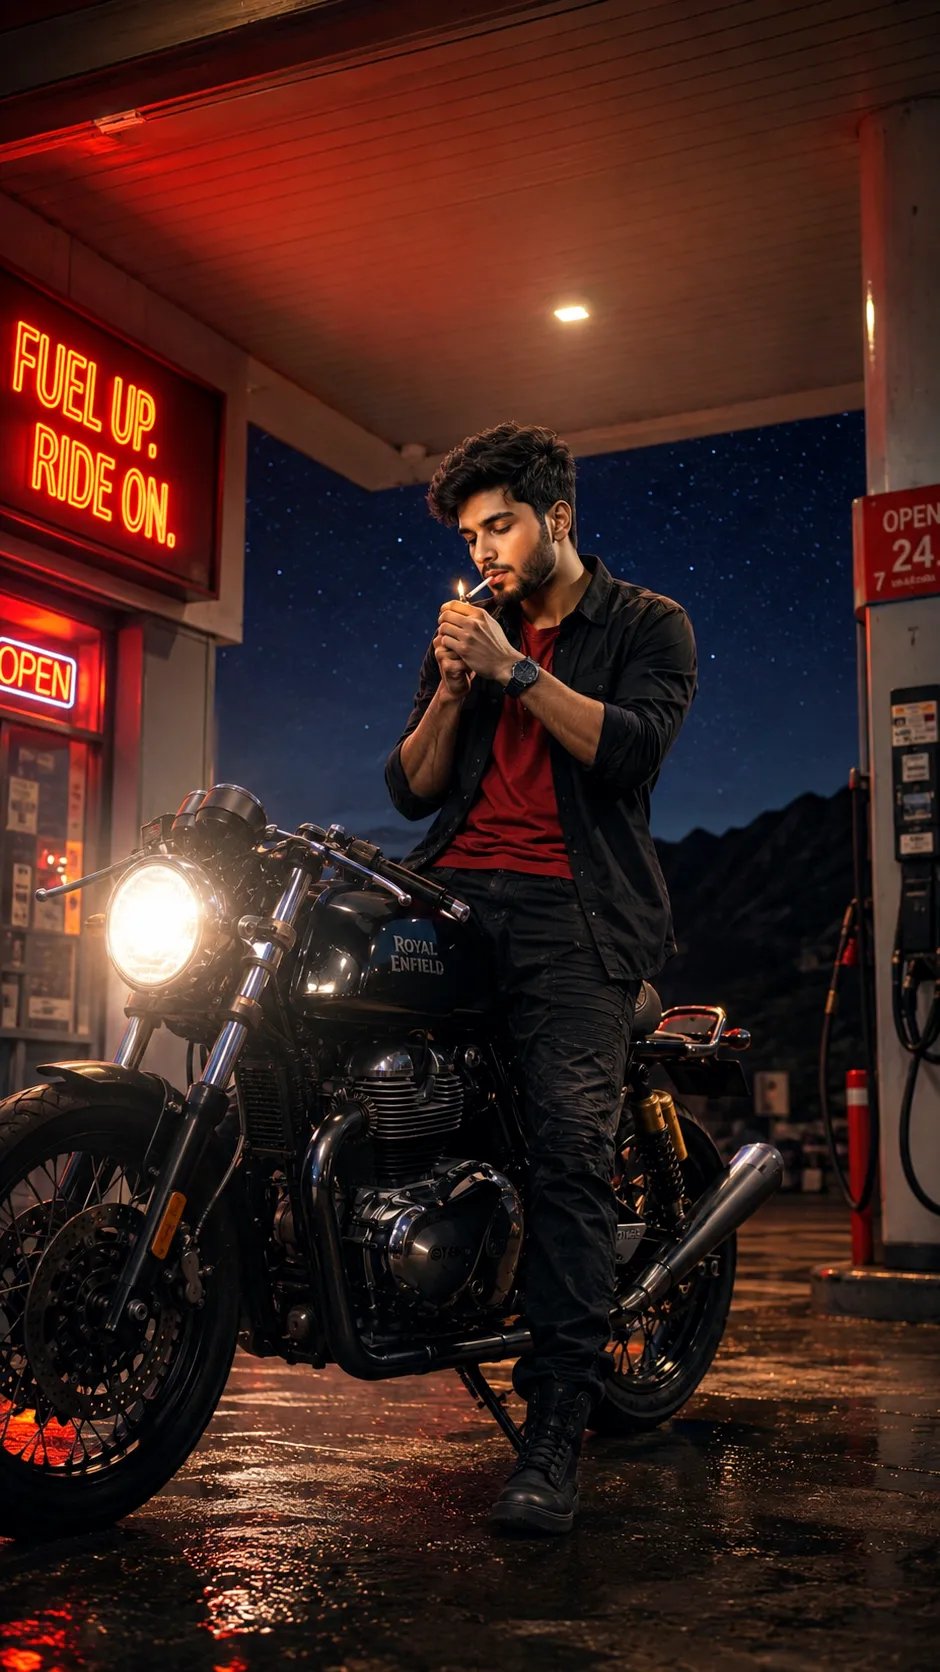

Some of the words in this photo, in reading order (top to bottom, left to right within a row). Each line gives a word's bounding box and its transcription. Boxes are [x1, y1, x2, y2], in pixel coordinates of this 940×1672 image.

[13, 320, 102, 433] FUEL
[111, 376, 157, 459] UP.
[32, 422, 115, 522] RIDE
[121, 467, 176, 548] ON.
[882, 502, 940, 533] OPEN
[0, 645, 72, 701] OPEN
[390, 954, 444, 975] ENFIELD
[393, 935, 438, 956] ROYAL
